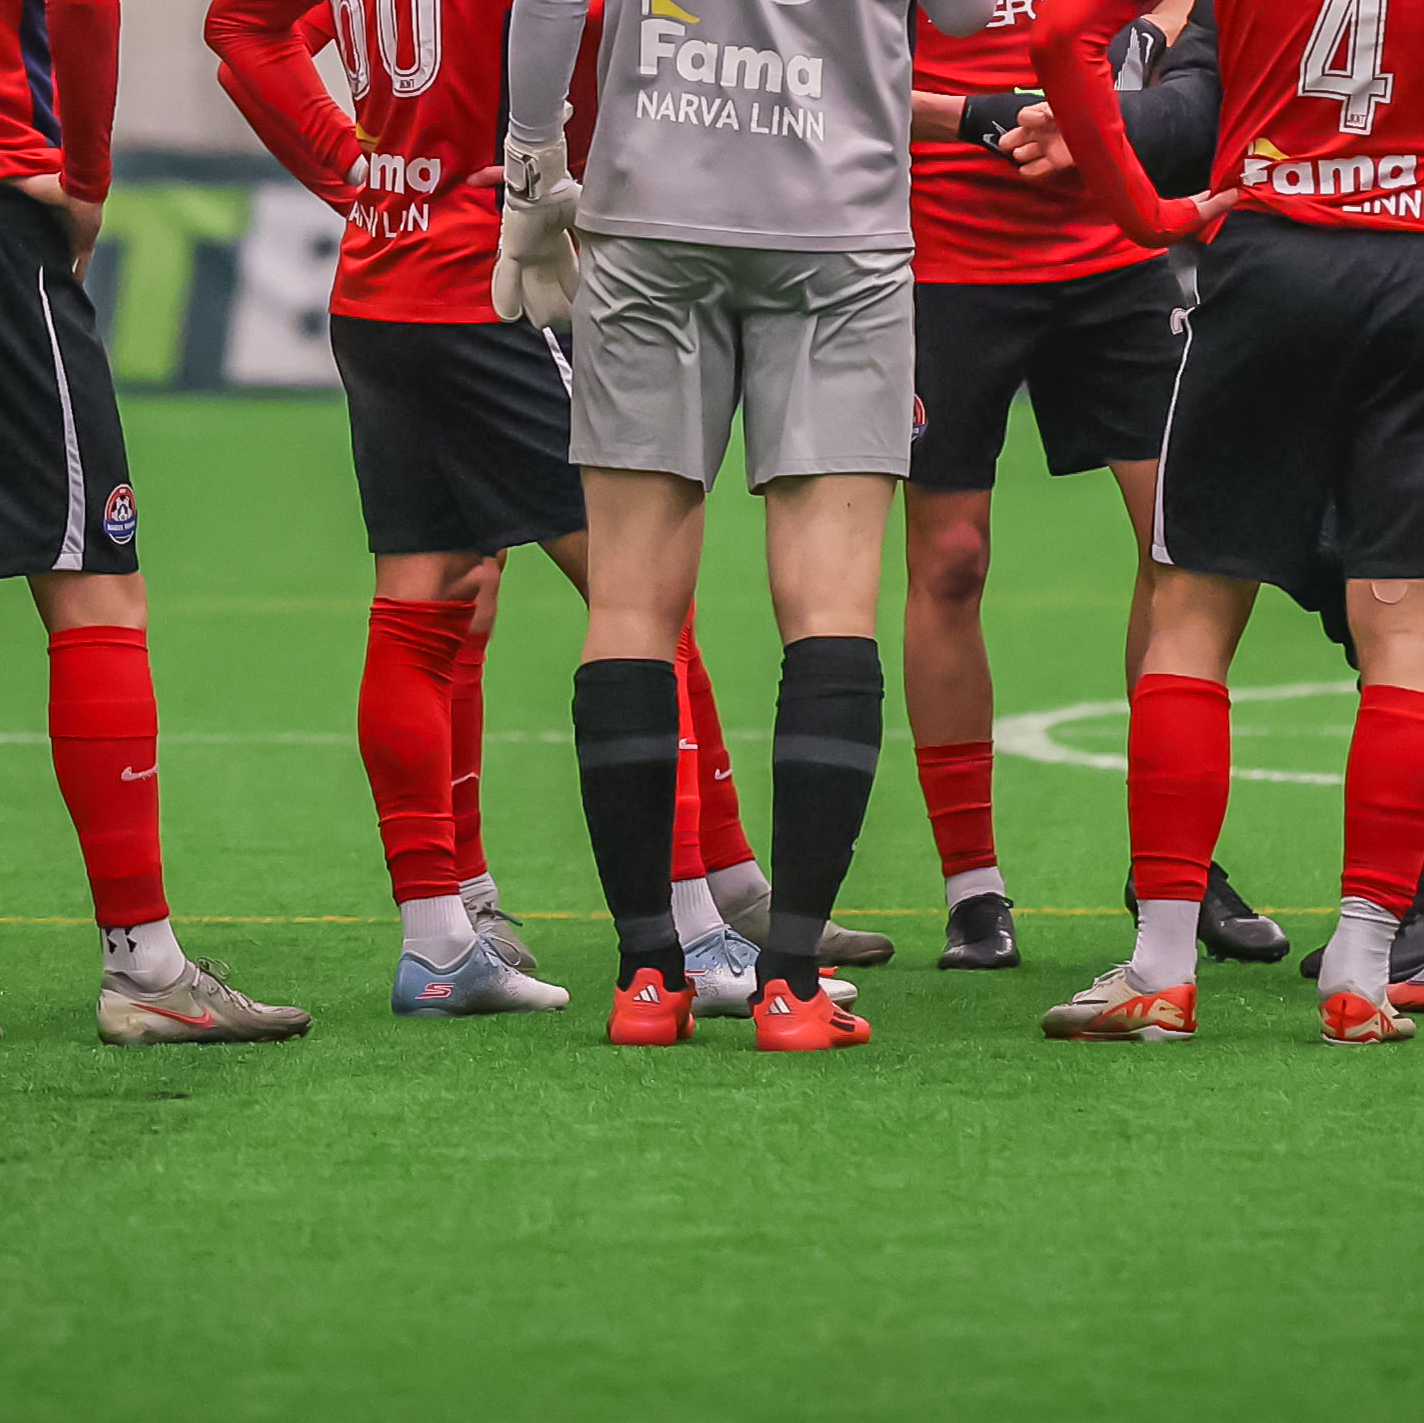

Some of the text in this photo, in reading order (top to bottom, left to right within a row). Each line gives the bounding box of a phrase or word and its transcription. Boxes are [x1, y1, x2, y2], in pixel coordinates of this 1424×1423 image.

[640, 18, 824, 98] Fama
[636, 90, 825, 141] NARVA LINN
[369, 151, 442, 195] ma
[1342, 189, 1423, 219] NN
